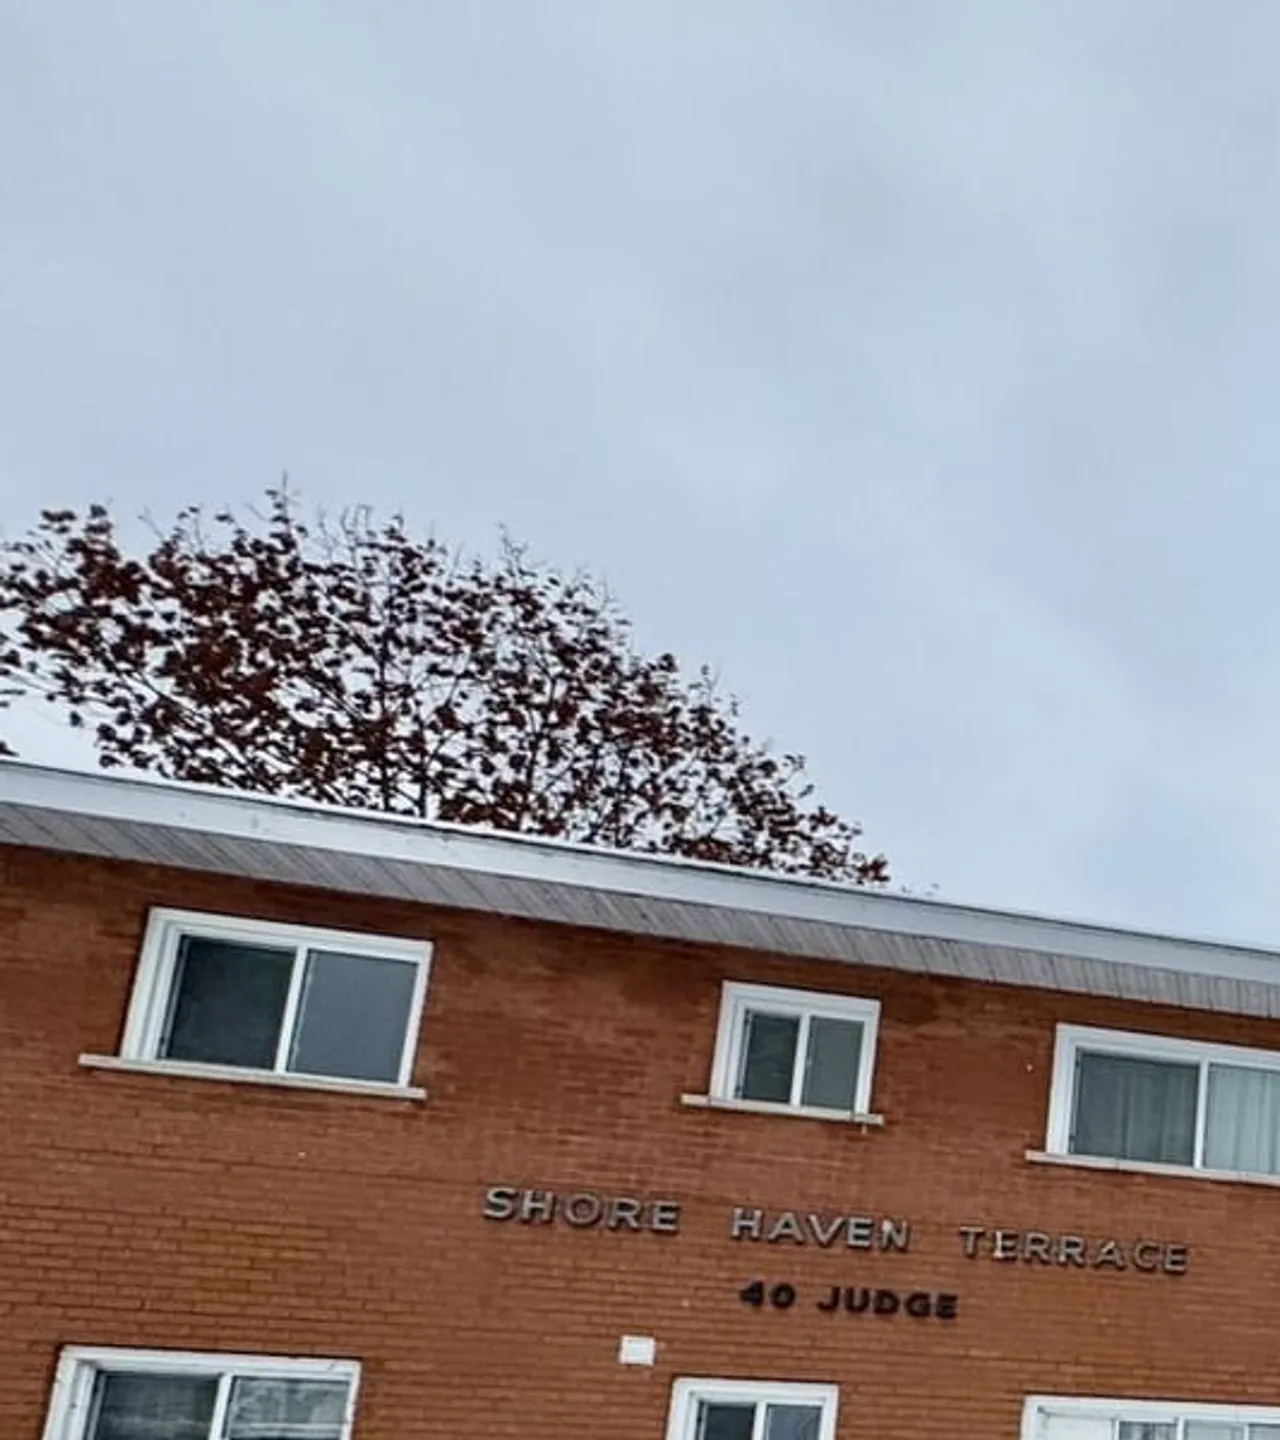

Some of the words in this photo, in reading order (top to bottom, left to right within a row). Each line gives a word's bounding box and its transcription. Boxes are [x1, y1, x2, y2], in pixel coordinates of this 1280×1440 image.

[483, 1187, 680, 1233] SHORE
[731, 1206, 910, 1253] HAVEN
[959, 1226, 1189, 1276] TERRACE
[739, 1281, 797, 1309] 40
[815, 1287, 959, 1320] JUDGE
